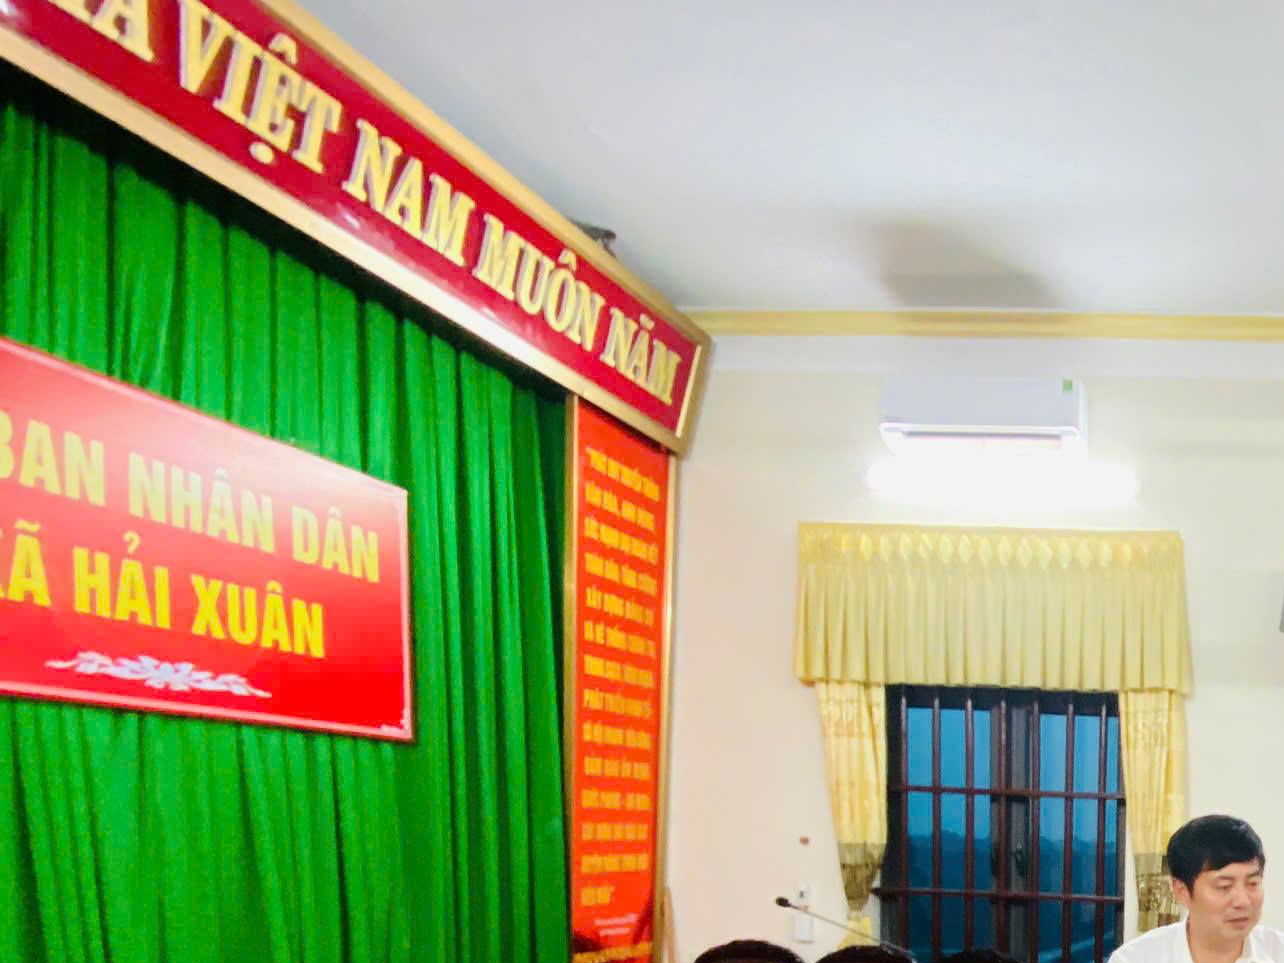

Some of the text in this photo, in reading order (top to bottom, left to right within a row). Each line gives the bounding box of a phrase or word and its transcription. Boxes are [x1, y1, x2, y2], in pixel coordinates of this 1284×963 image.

[48, 0, 682, 405] A VIỆT NAM MUÔN NĂM
[129, 451, 276, 553] NHÂN
[291, 504, 380, 583] DÂN
[0, 518, 326, 659] Ã HẢI XUÂN
